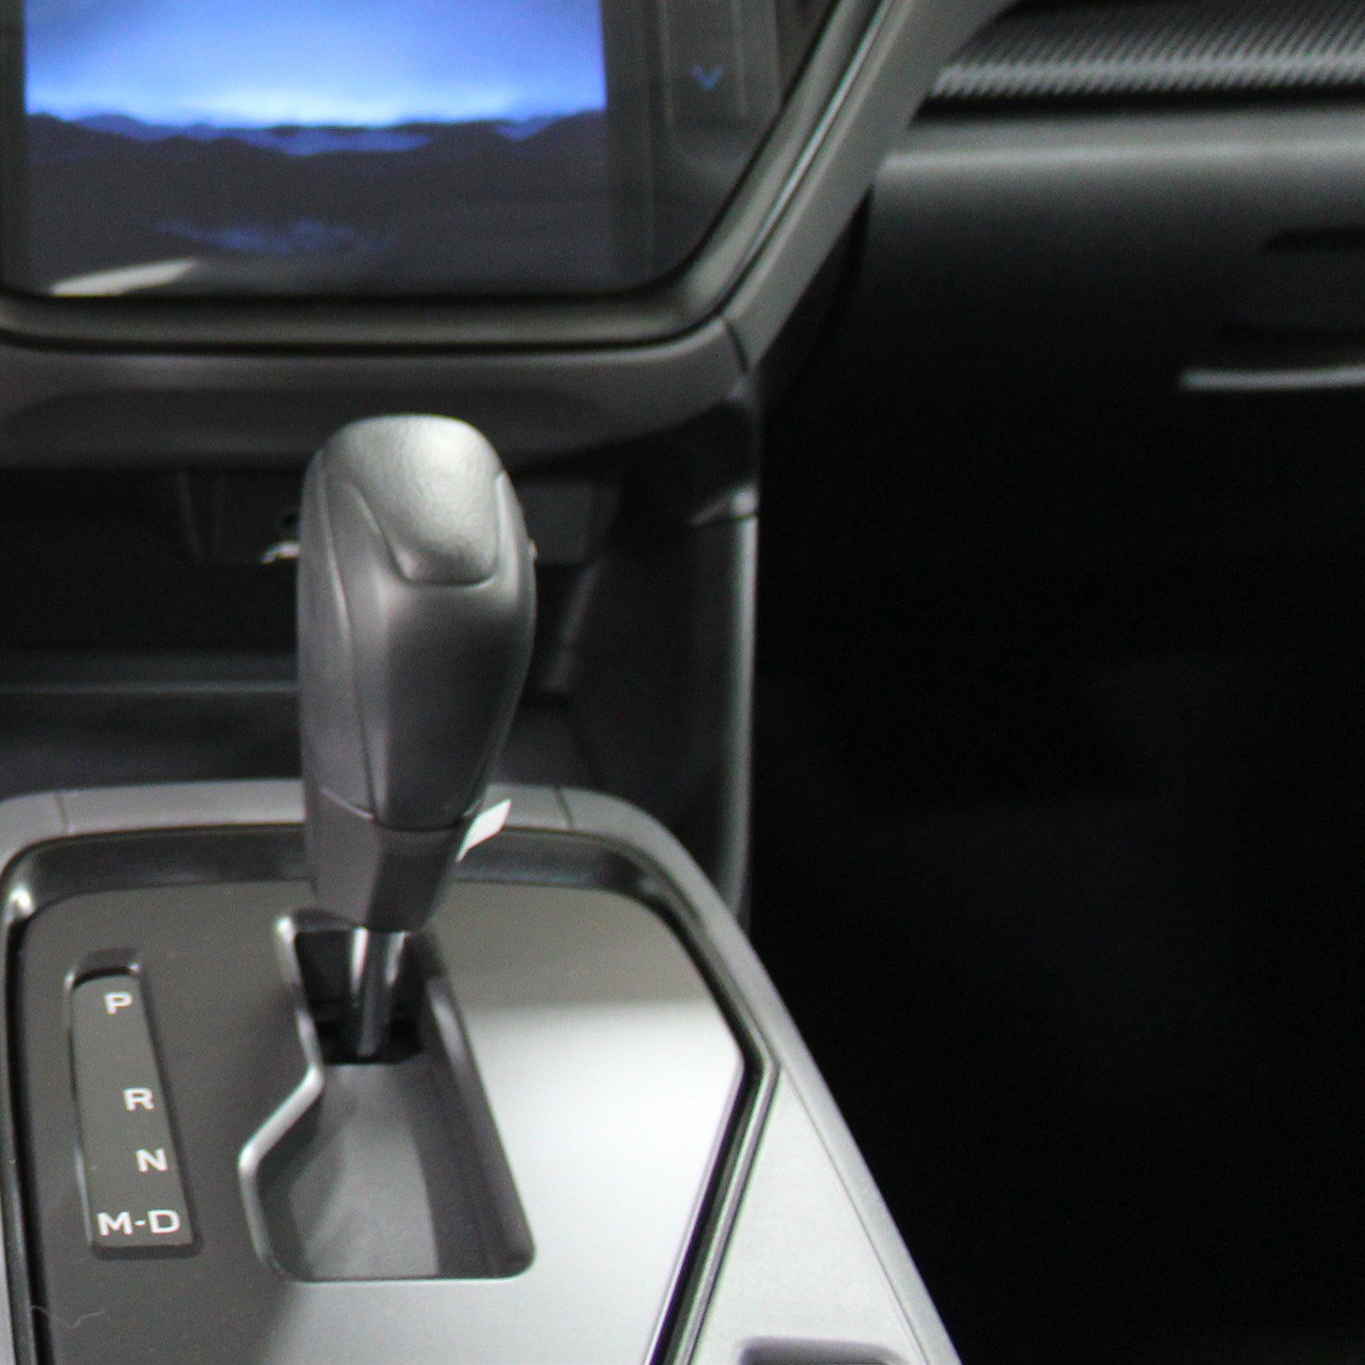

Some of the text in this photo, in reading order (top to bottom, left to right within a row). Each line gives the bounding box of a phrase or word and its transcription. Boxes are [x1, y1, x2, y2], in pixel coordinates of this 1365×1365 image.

[104, 991, 133, 1015] P
[123, 1087, 155, 1111] R
[135, 1148, 168, 1172] N
[96, 1209, 181, 1237] M-D
